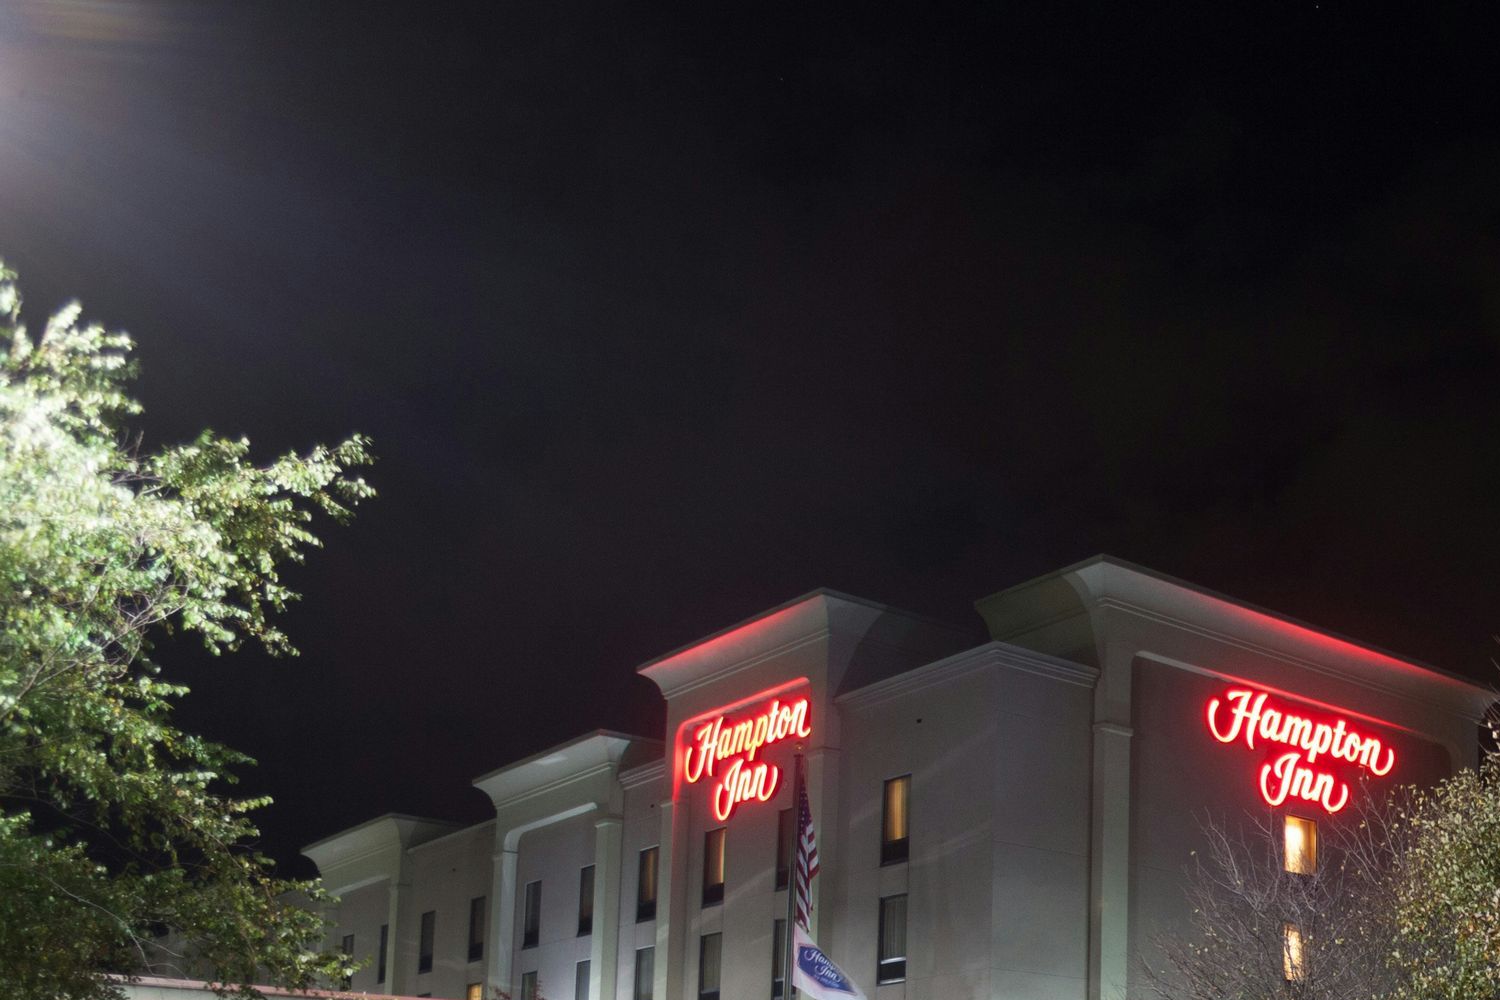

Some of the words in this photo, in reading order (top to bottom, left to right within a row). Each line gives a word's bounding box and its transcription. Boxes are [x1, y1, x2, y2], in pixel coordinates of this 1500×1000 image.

[685, 699, 811, 783] Hampton
[1208, 690, 1395, 776] Hampton
[715, 758, 779, 821] Inn
[1260, 752, 1348, 813] Inn
[814, 964, 844, 983] Inn
